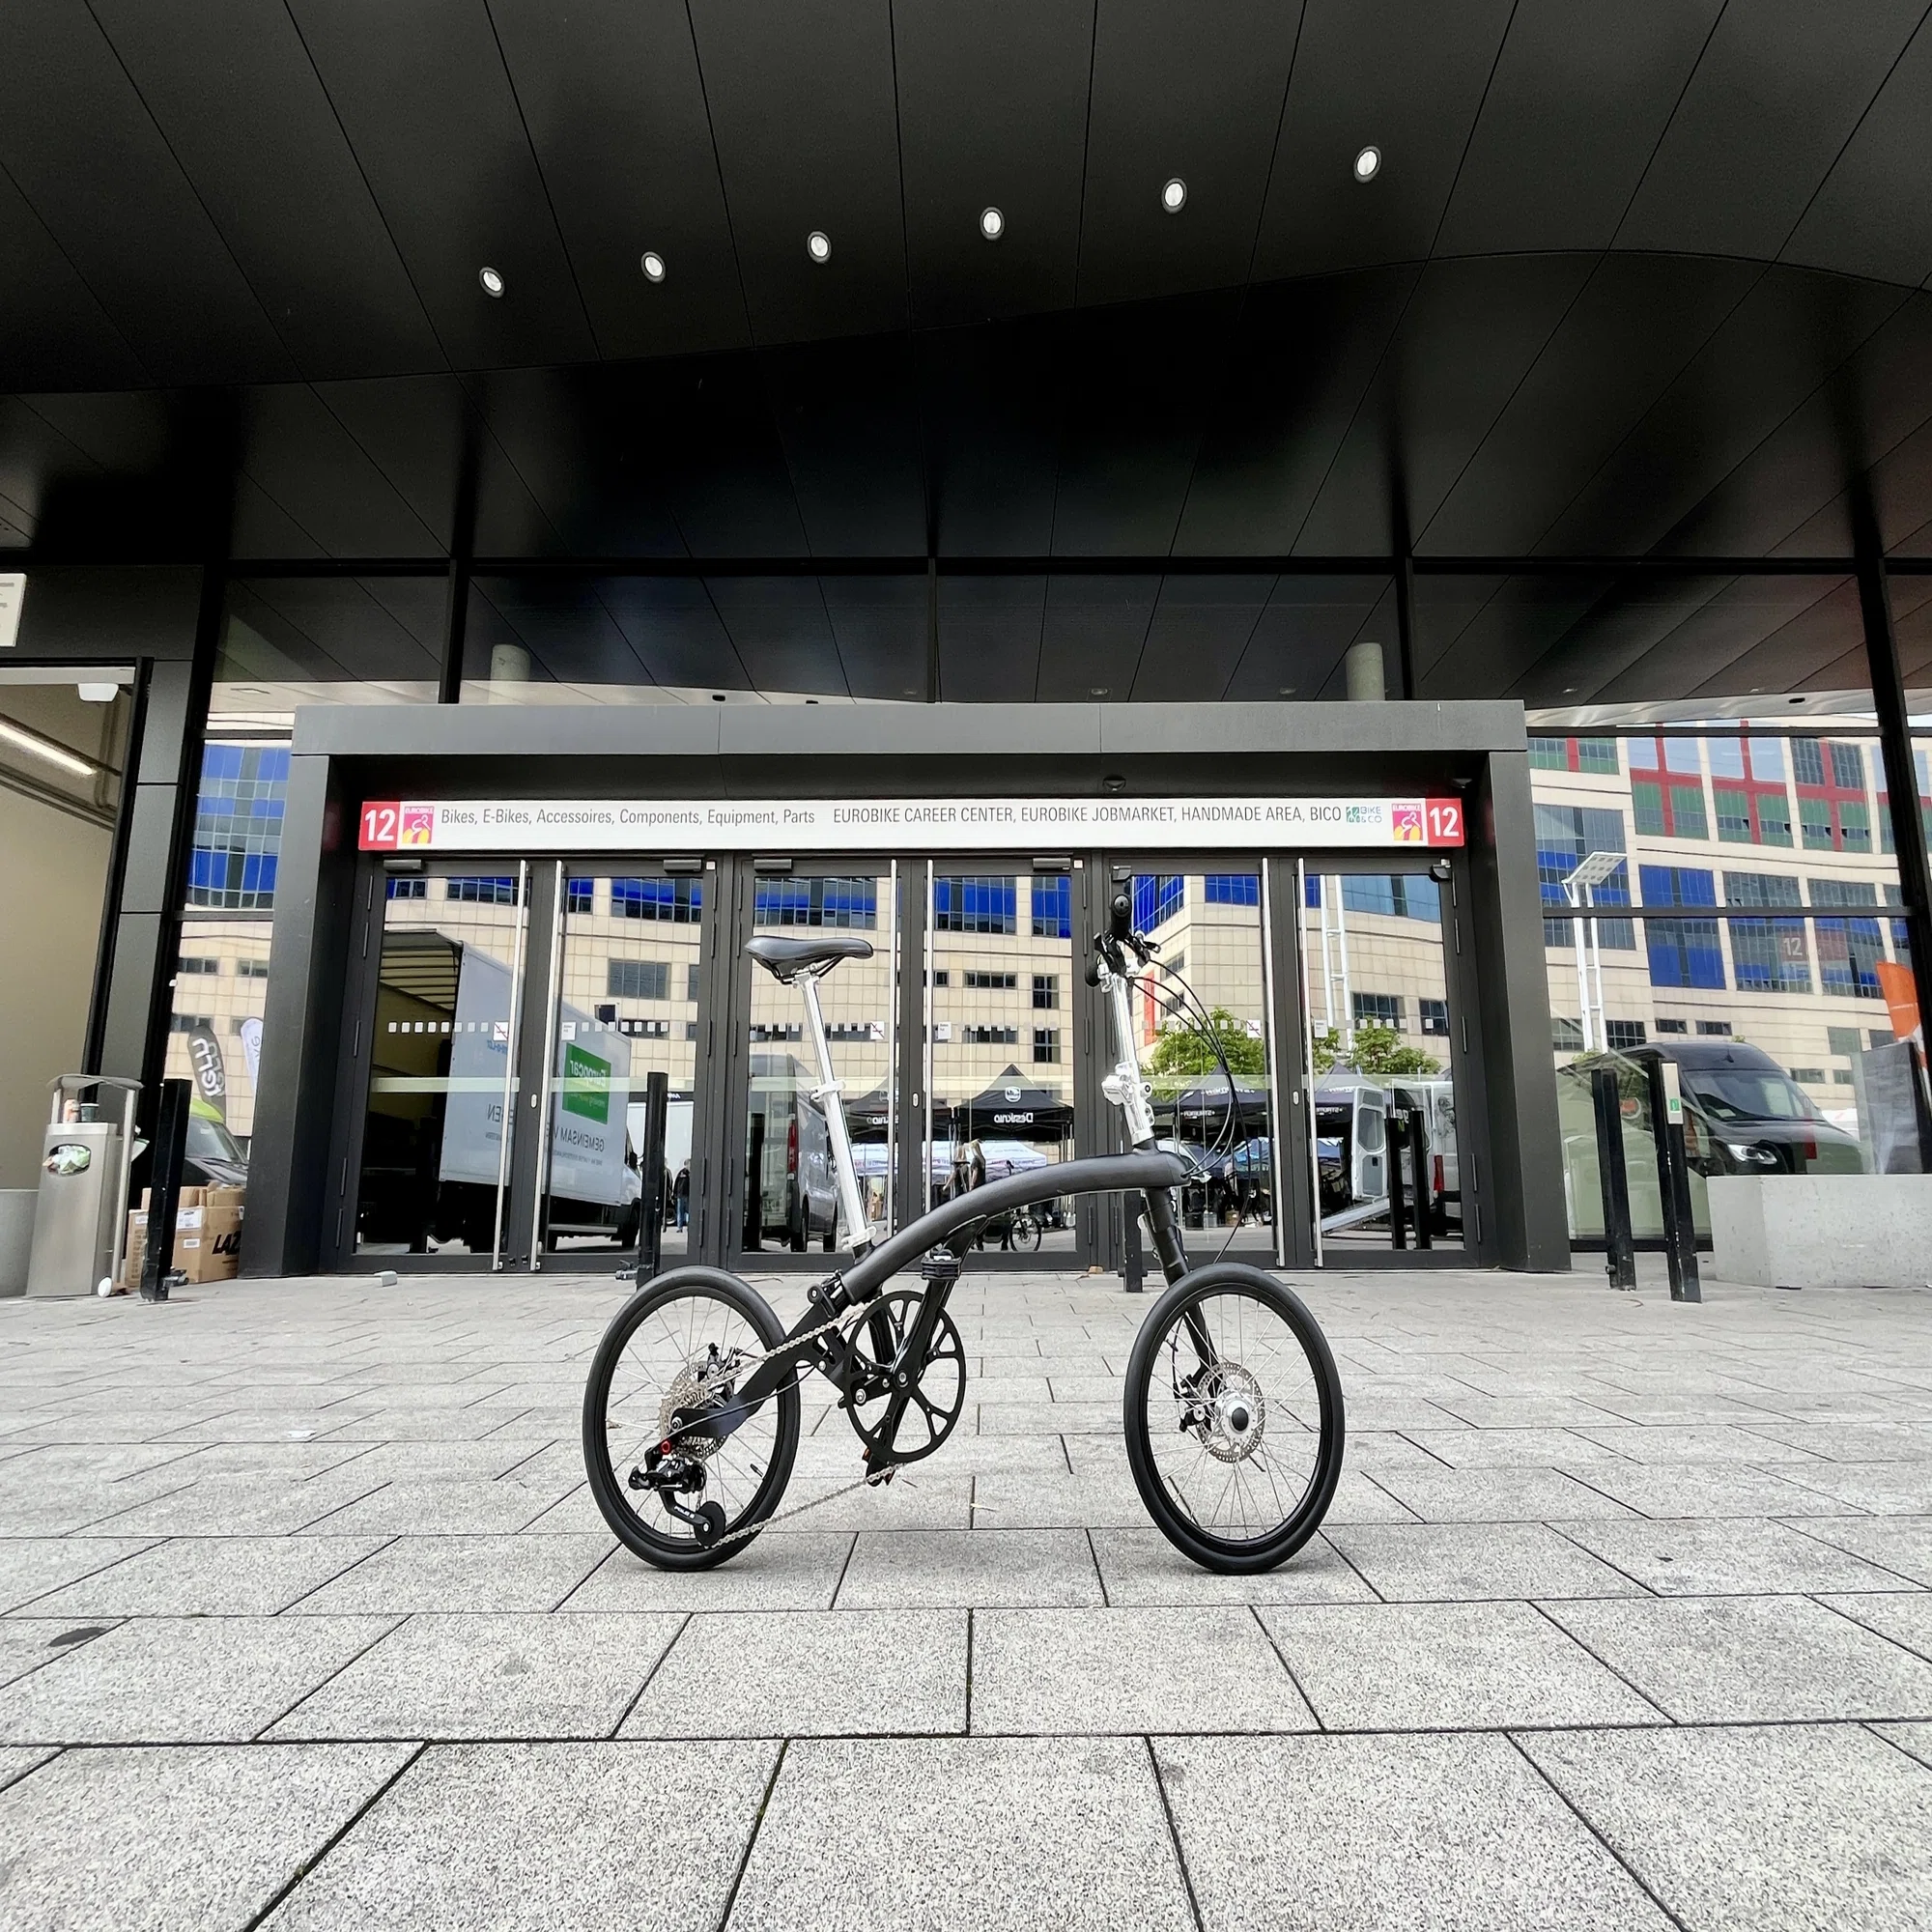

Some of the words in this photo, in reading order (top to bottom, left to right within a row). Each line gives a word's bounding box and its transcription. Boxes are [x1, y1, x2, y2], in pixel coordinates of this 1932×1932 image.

[440, 809, 478, 825] Bikes,
[482, 809, 532, 825] E-Bikes,
[536, 809, 615, 825] Accessoires,
[619, 809, 703, 827] Components,
[707, 809, 779, 827] Equipment,
[783, 809, 815, 824] Parts
[833, 808, 900, 823] EUROBIKE
[904, 808, 956, 823] CAREER
[960, 807, 1016, 823] CENTER,
[1021, 807, 1088, 822] EUROBIKE
[1092, 807, 1178, 822] JOBMARKET,
[1181, 806, 1262, 821] HANDMADE
[1264, 806, 1306, 822] AREA,
[1310, 806, 1342, 821] BICO
[1360, 806, 1381, 814] BIKE
[364, 809, 396, 841] 12
[1429, 807, 1460, 838] 12
[1783, 937, 1804, 956] 12
